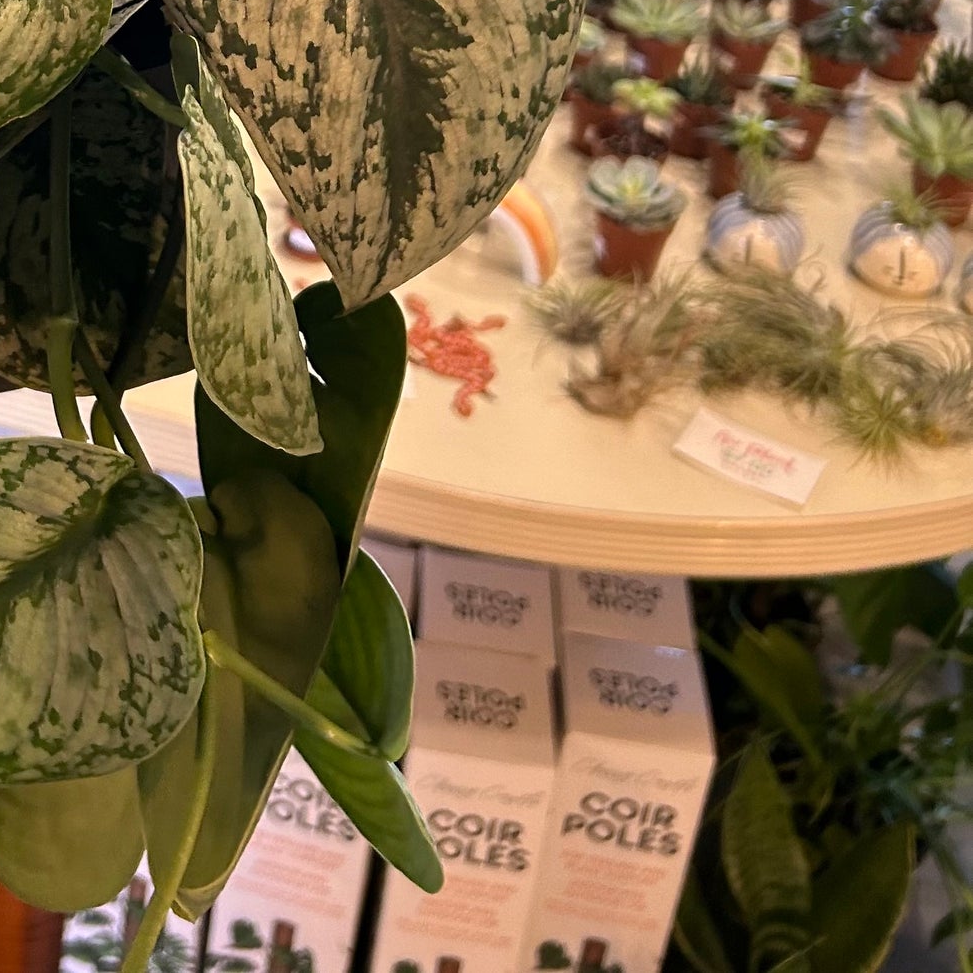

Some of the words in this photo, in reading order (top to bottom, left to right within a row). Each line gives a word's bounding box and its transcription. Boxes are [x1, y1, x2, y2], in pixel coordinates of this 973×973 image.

[266, 798, 356, 842] OLES
[427, 808, 524, 844] COIR
[579, 791, 678, 829] COIR
[434, 835, 531, 872] OLES
[560, 812, 684, 857] POLES
